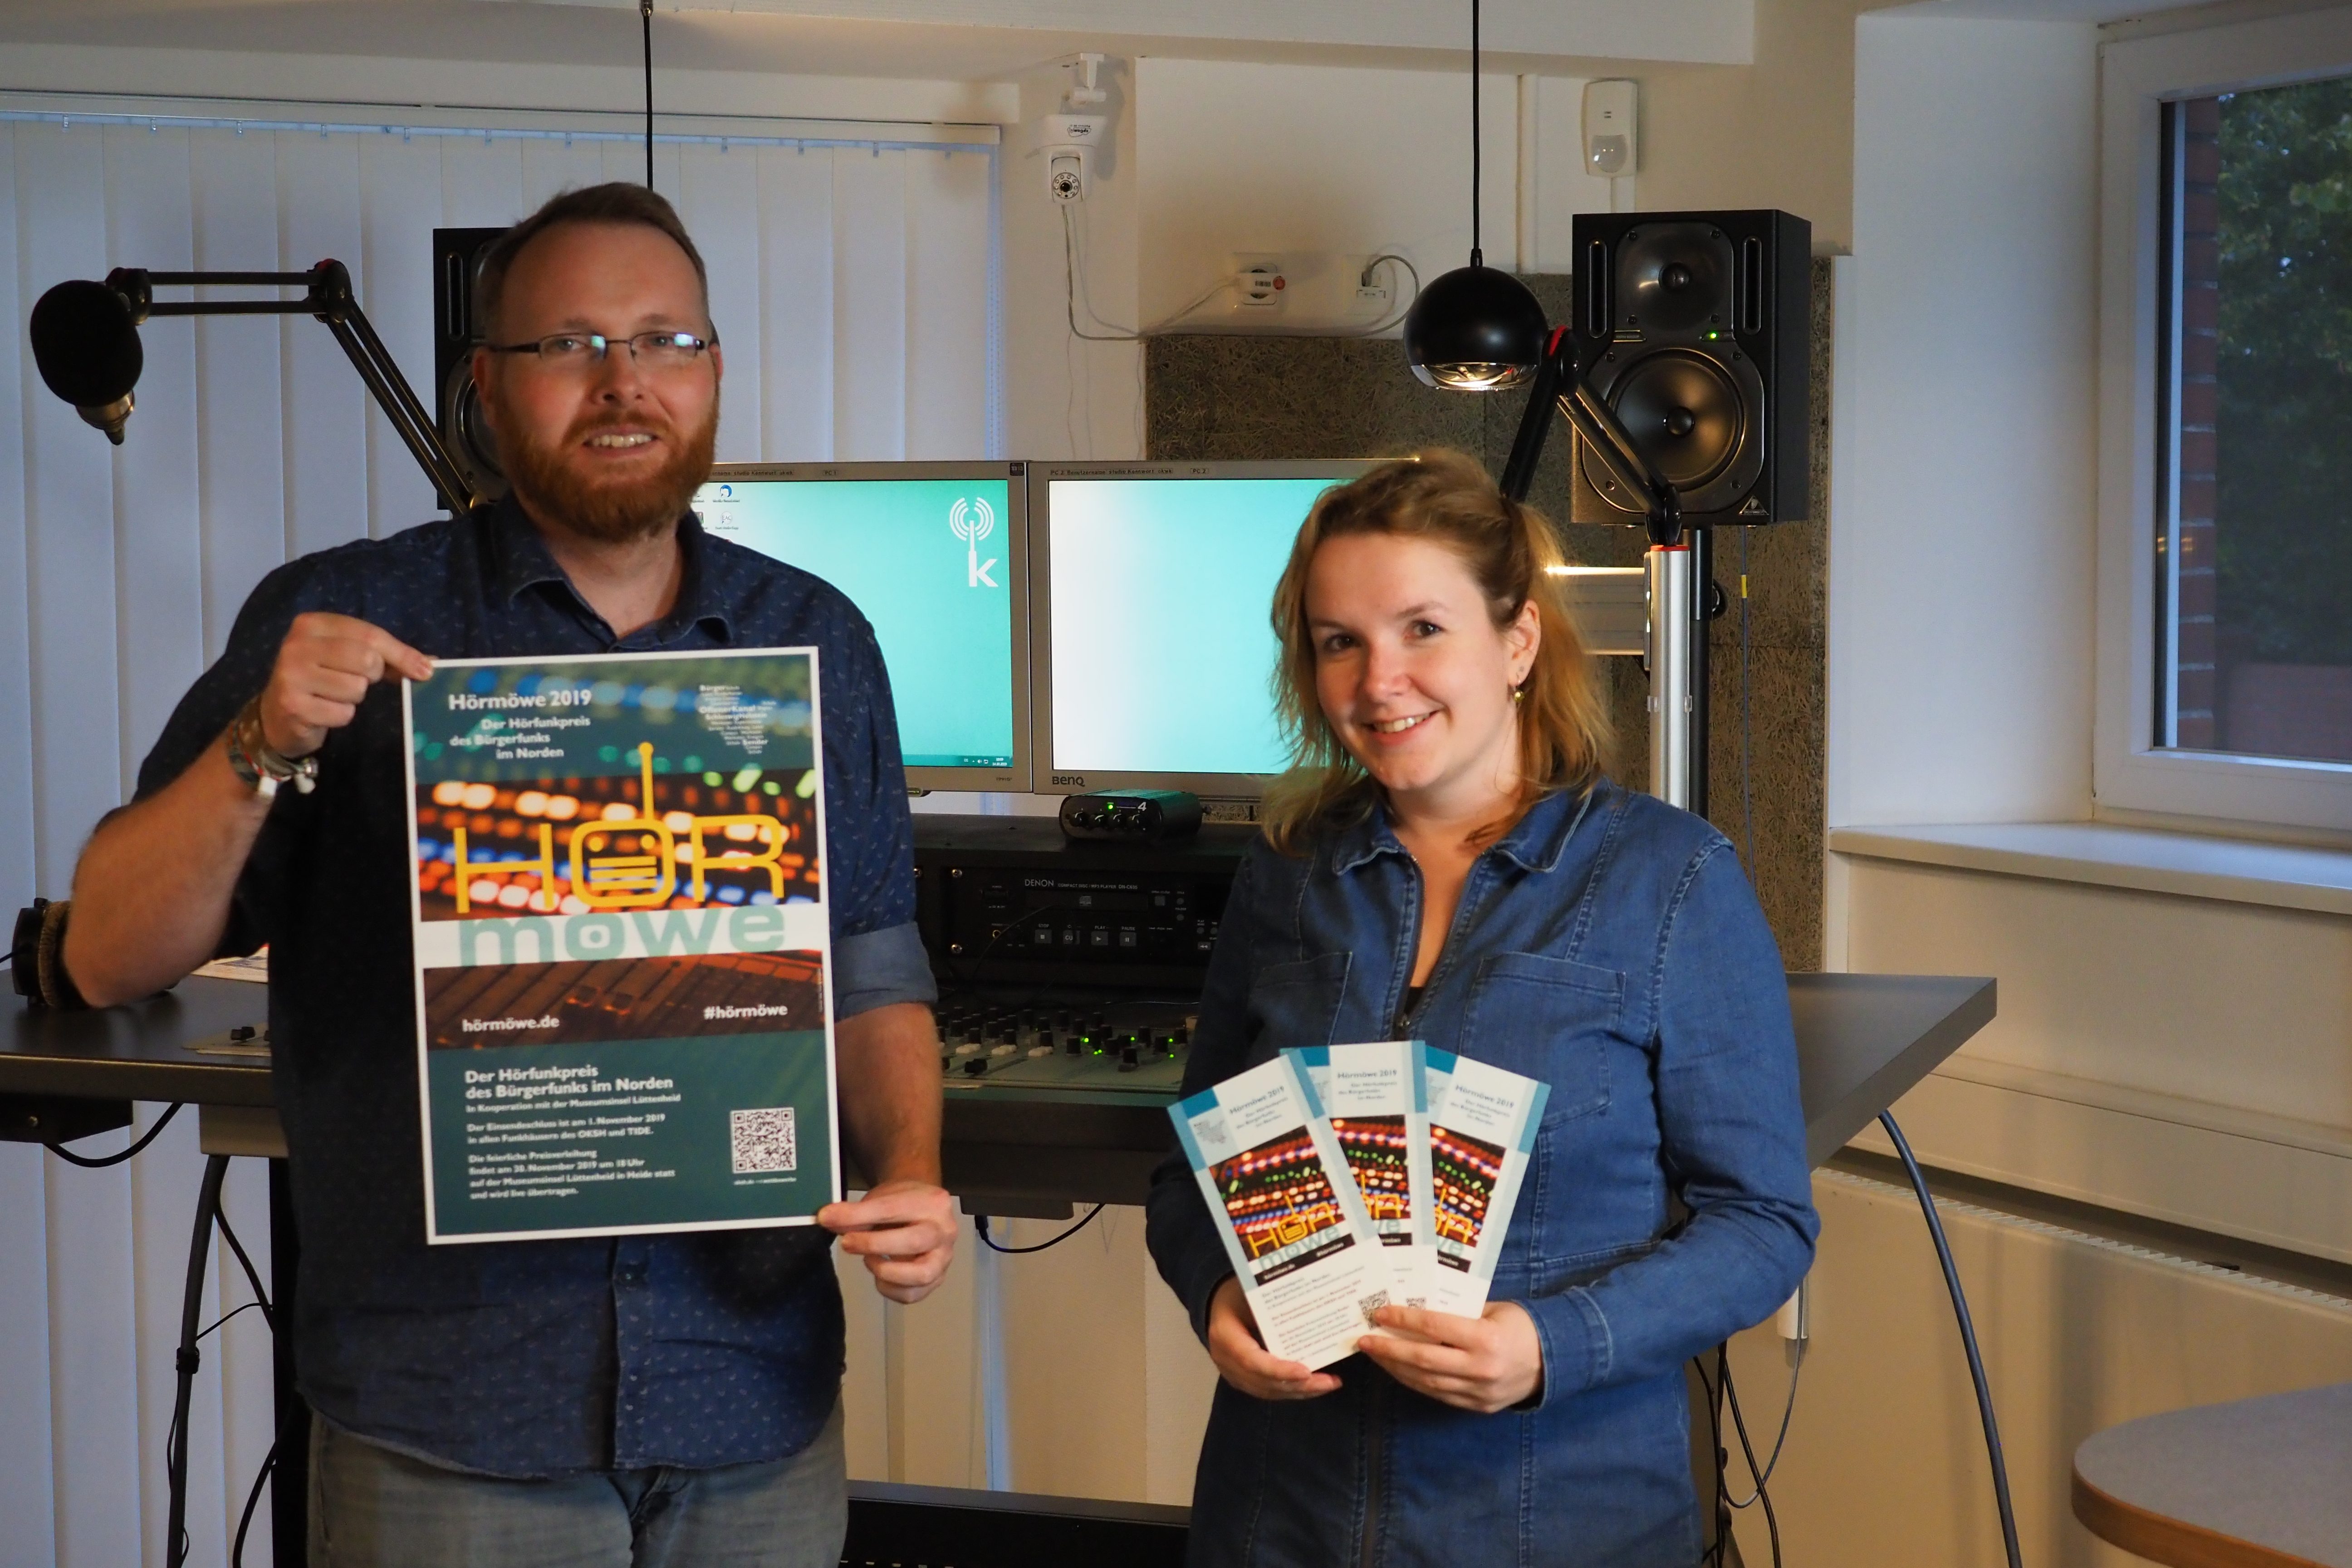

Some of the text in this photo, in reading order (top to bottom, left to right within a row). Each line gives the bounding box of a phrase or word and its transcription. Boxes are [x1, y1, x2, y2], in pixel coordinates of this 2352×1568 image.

[448, 689, 592, 710] Hörmöwe 2019
[481, 715, 591, 730] Der Hörfunkpreis
[450, 732, 551, 747] des Bürgerfunks
[496, 747, 564, 759] im Norden
[1052, 776, 1086, 787] BenQ
[1024, 879, 1054, 887] DENON
[704, 1004, 788, 1020] #hörmöwe
[462, 1014, 560, 1033] hörmöwe.de
[465, 1064, 599, 1083] Der Hörfunkpreis
[466, 1077, 673, 1100] des Bürgerfunks im Norden
[1267, 1085, 1285, 1098] 2019
[477, 1102, 534, 1113] Kooperation
[534, 1101, 551, 1109] mit
[552, 1100, 568, 1109] der
[568, 1096, 631, 1107] Museumsinsel
[1496, 1097, 1514, 1108] 2019
[466, 1123, 486, 1132] Der
[558, 1119, 570, 1127] ist
[645, 1113, 666, 1123] 2019
[478, 1135, 501, 1144] allen
[560, 1131, 576, 1140] des
[577, 1129, 607, 1139] OKSH
[608, 1128, 626, 1137] und
[627, 1126, 654, 1136] TIDE.
[468, 1154, 485, 1163] Die
[577, 1161, 598, 1170] 2019
[485, 1178, 502, 1187] der
[470, 1191, 488, 1200] und
